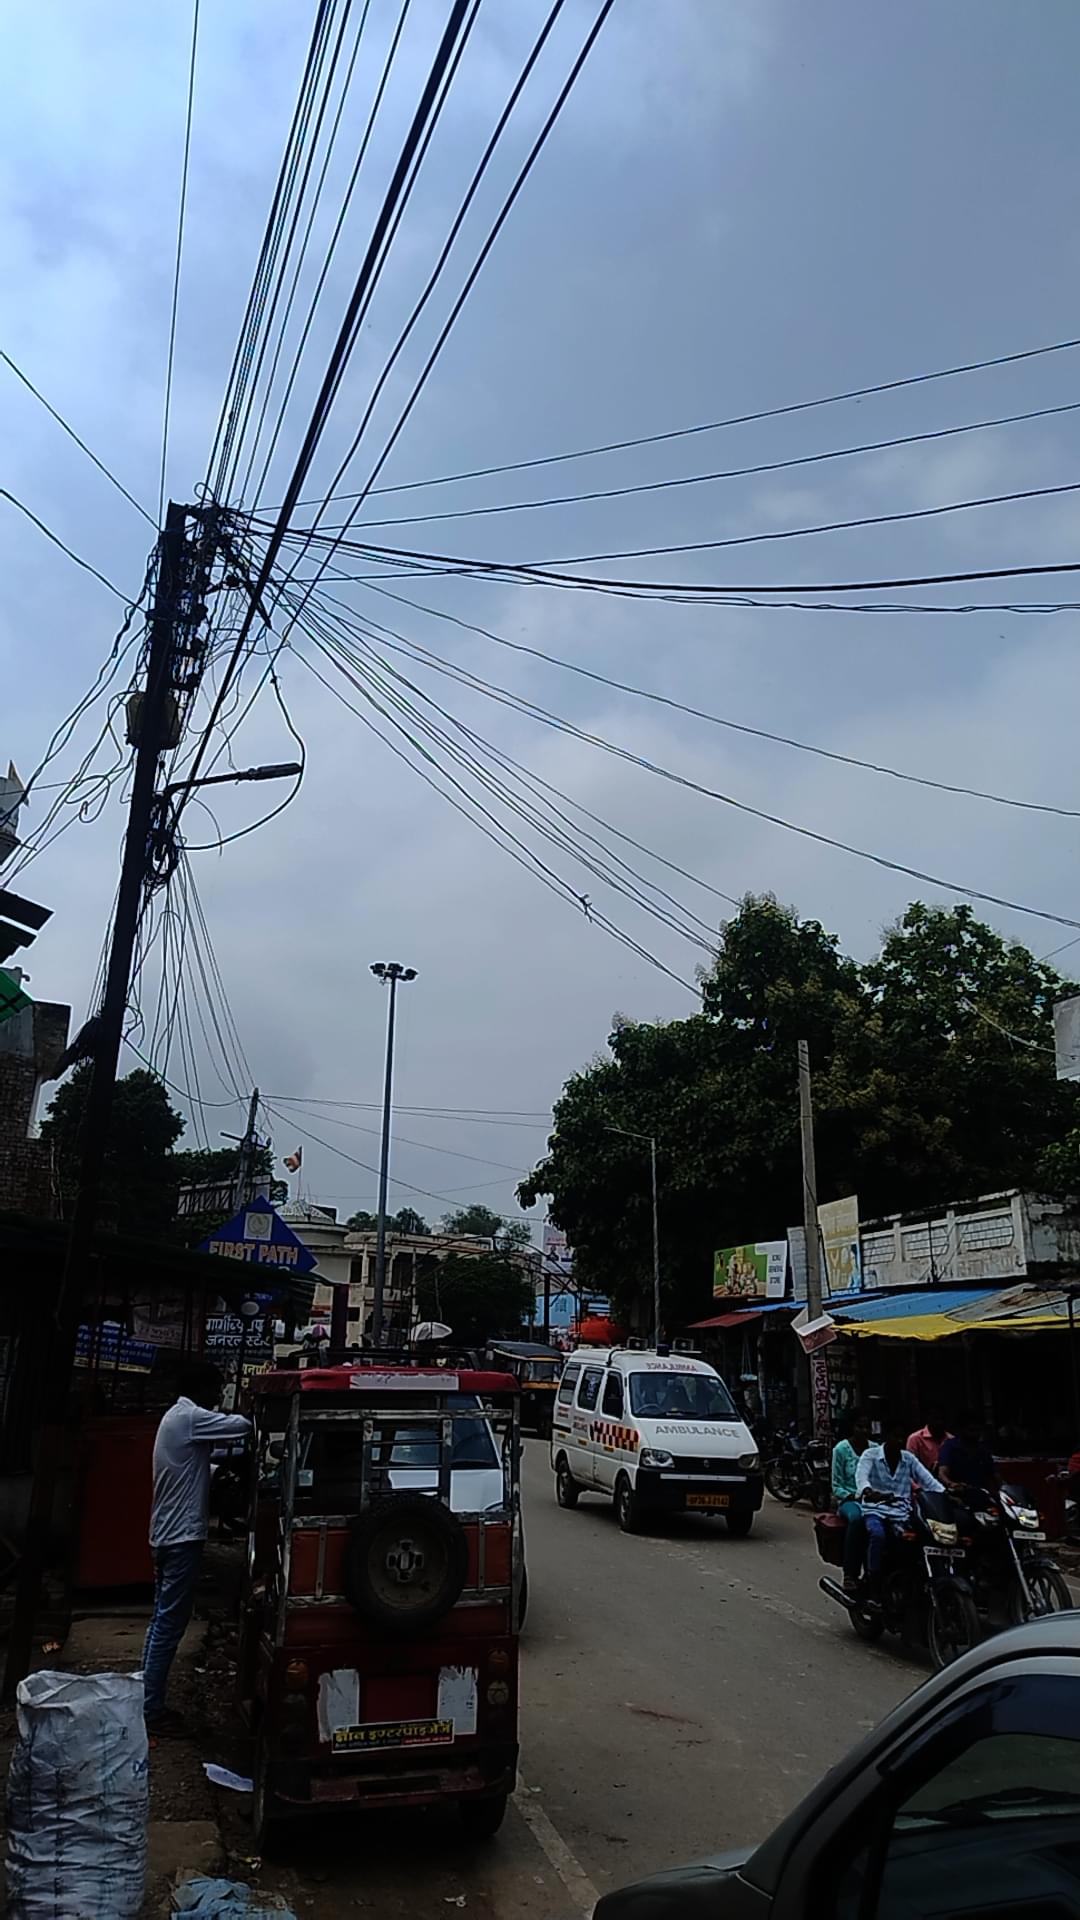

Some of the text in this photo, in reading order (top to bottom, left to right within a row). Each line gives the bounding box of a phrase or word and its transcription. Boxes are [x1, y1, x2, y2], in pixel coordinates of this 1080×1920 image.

[208, 1241, 299, 1265] FIRST PATH
[655, 1425, 741, 1438] AMBULANCE
